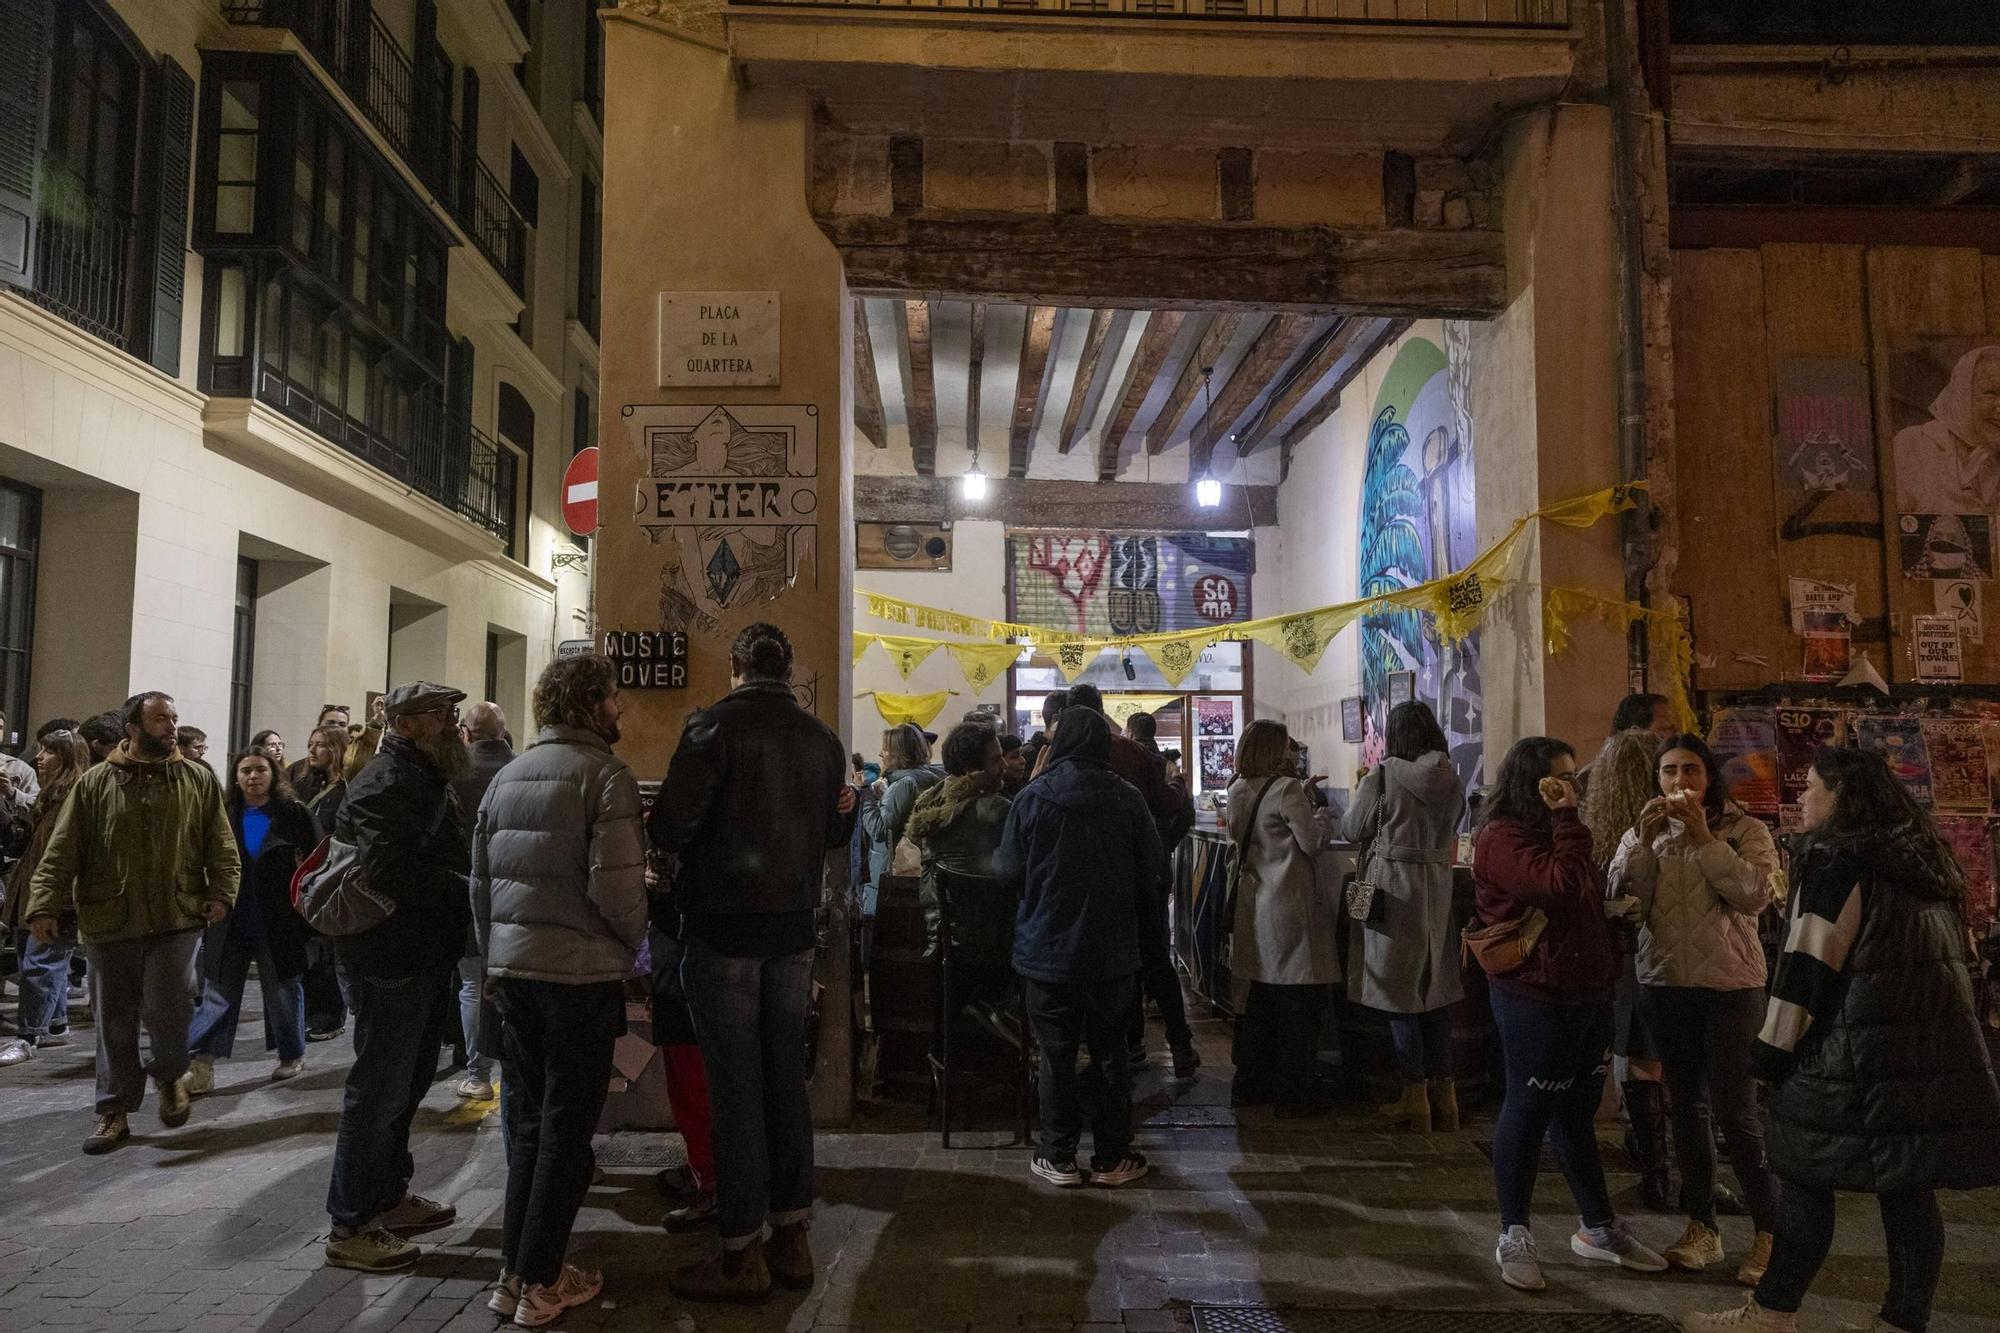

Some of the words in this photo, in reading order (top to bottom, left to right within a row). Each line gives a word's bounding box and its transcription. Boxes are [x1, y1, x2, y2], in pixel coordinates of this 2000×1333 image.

[702, 332, 717, 346] DE
[722, 332, 739, 346] LA
[687, 358, 753, 373] QUARTERA
[655, 482, 782, 518] ETHER
[1203, 578, 1229, 600] SO
[604, 635, 685, 657] MUSIC
[621, 664, 685, 686] OVER
